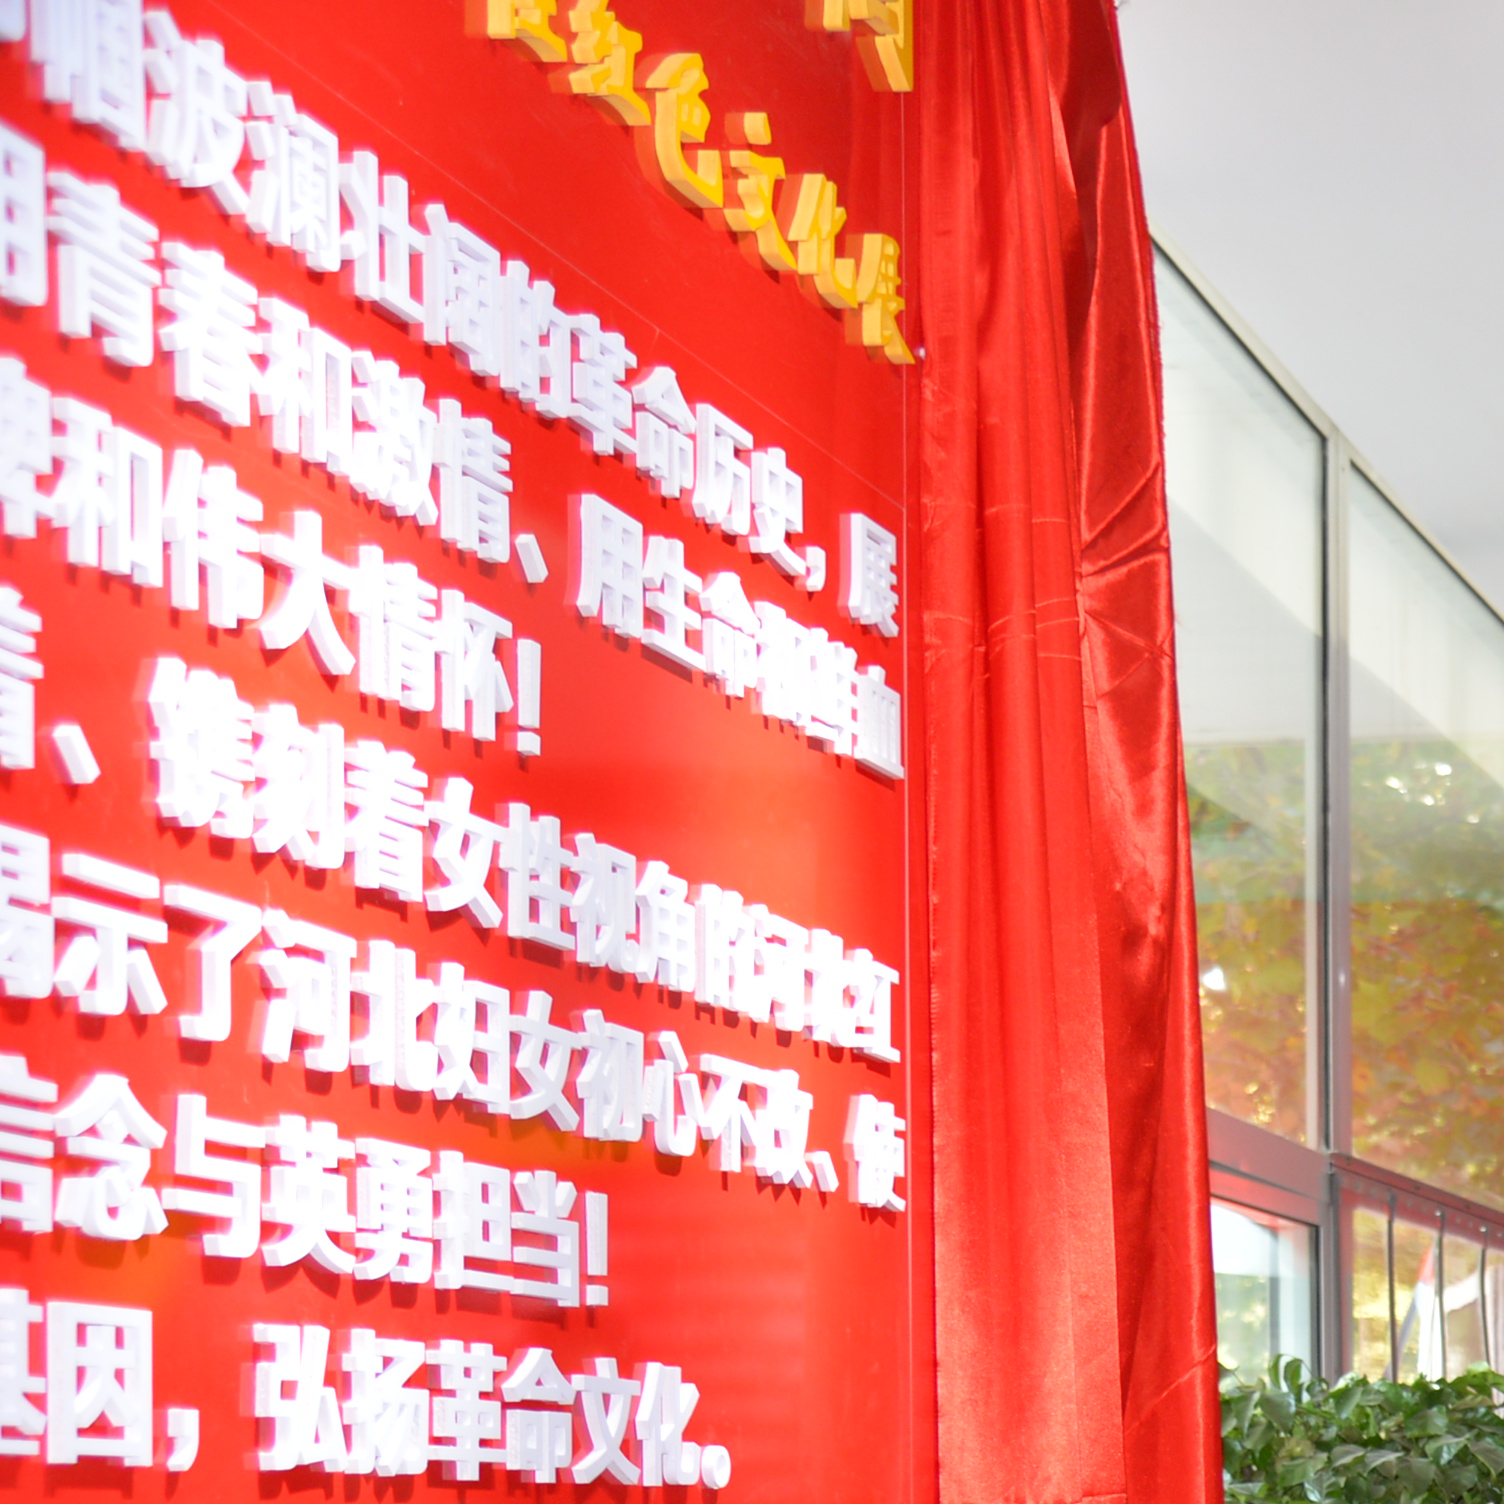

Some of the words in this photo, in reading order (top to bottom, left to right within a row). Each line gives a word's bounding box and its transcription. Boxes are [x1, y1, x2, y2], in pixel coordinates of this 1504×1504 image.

[0, 0, 899, 638] 幅波澜壮阔的革命历史，展
